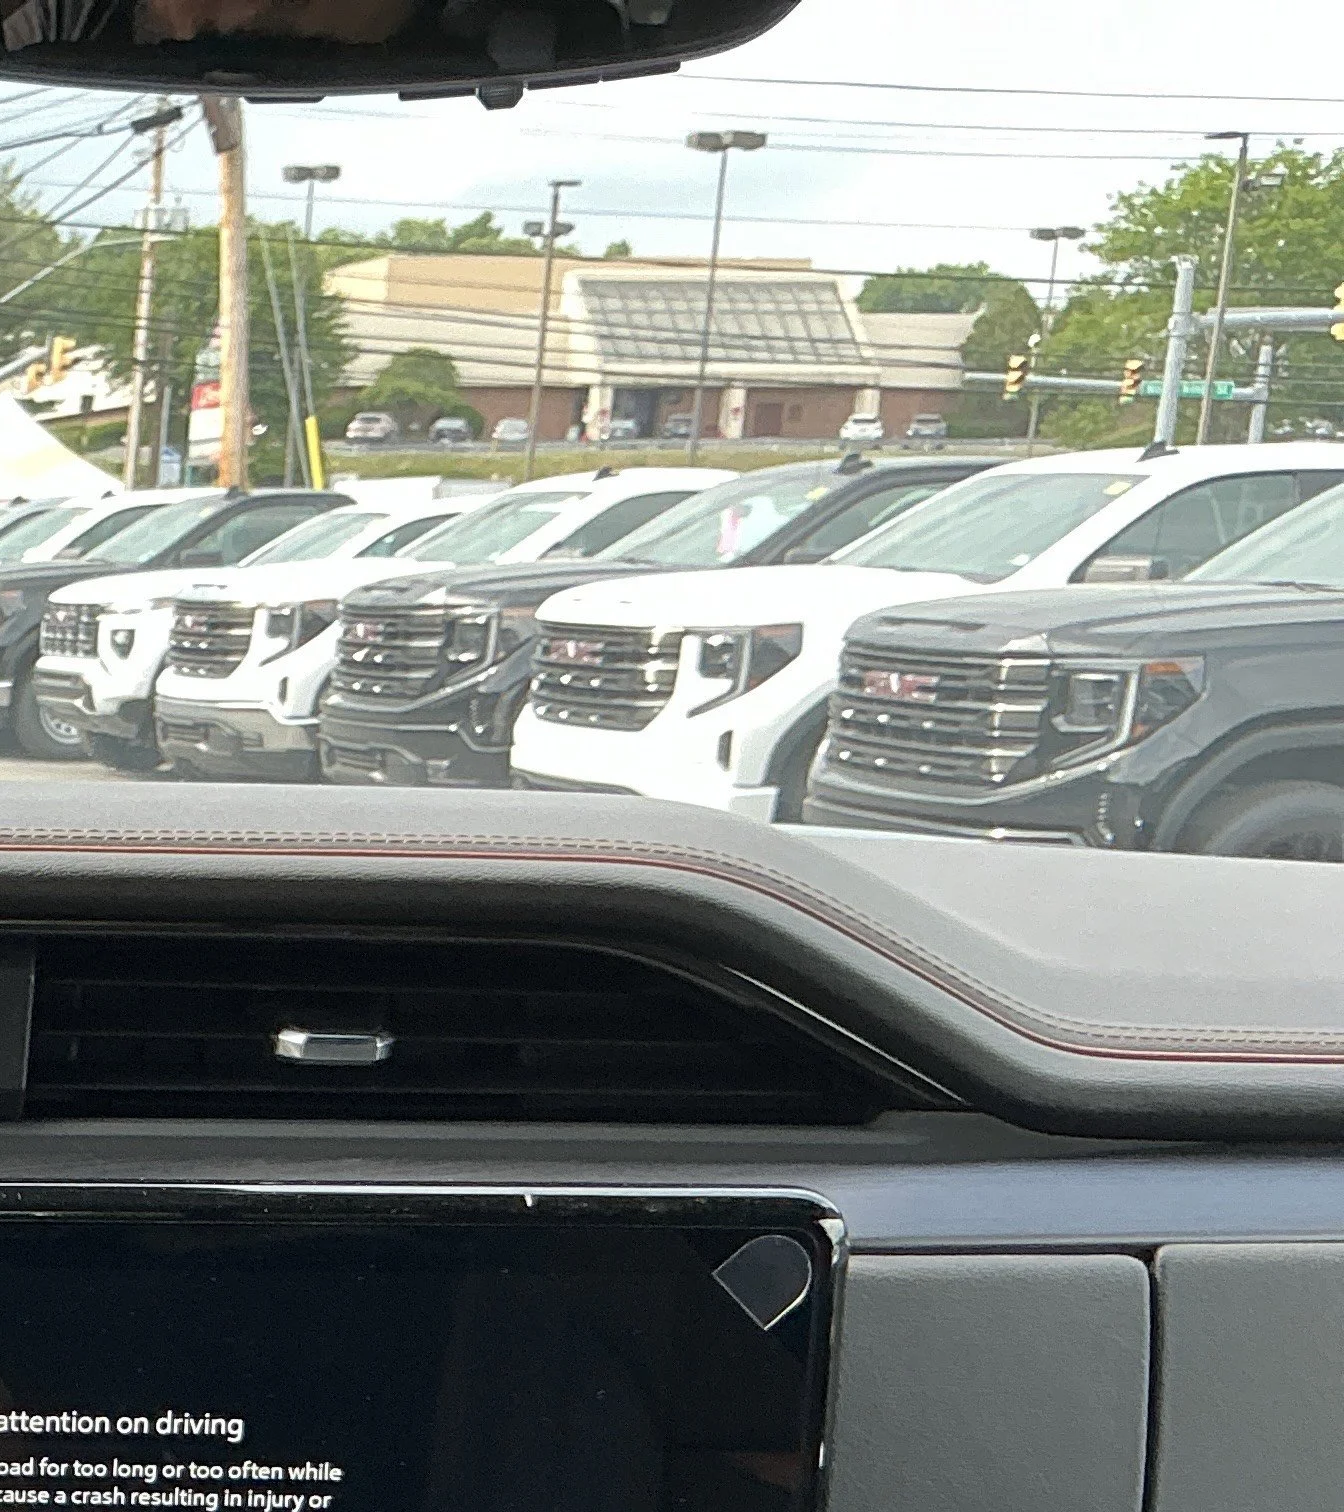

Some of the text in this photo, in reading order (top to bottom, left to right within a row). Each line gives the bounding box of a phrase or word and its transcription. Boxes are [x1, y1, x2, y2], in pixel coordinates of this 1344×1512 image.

[116, 1416, 149, 1434] on
[155, 1410, 244, 1443] driving
[39, 1457, 69, 1477] for
[72, 1460, 107, 1477] too
[113, 1458, 157, 1483] long
[162, 1463, 186, 1479] or
[188, 1461, 223, 1479] too
[228, 1460, 283, 1480] often
[288, 1462, 343, 1482] while
[54, 1490, 67, 1504] a
[71, 1486, 125, 1506] crash
[130, 1487, 218, 1512] resulting
[223, 1489, 242, 1507] in
[247, 1489, 305, 1512] injury
[308, 1493, 332, 1509] or
